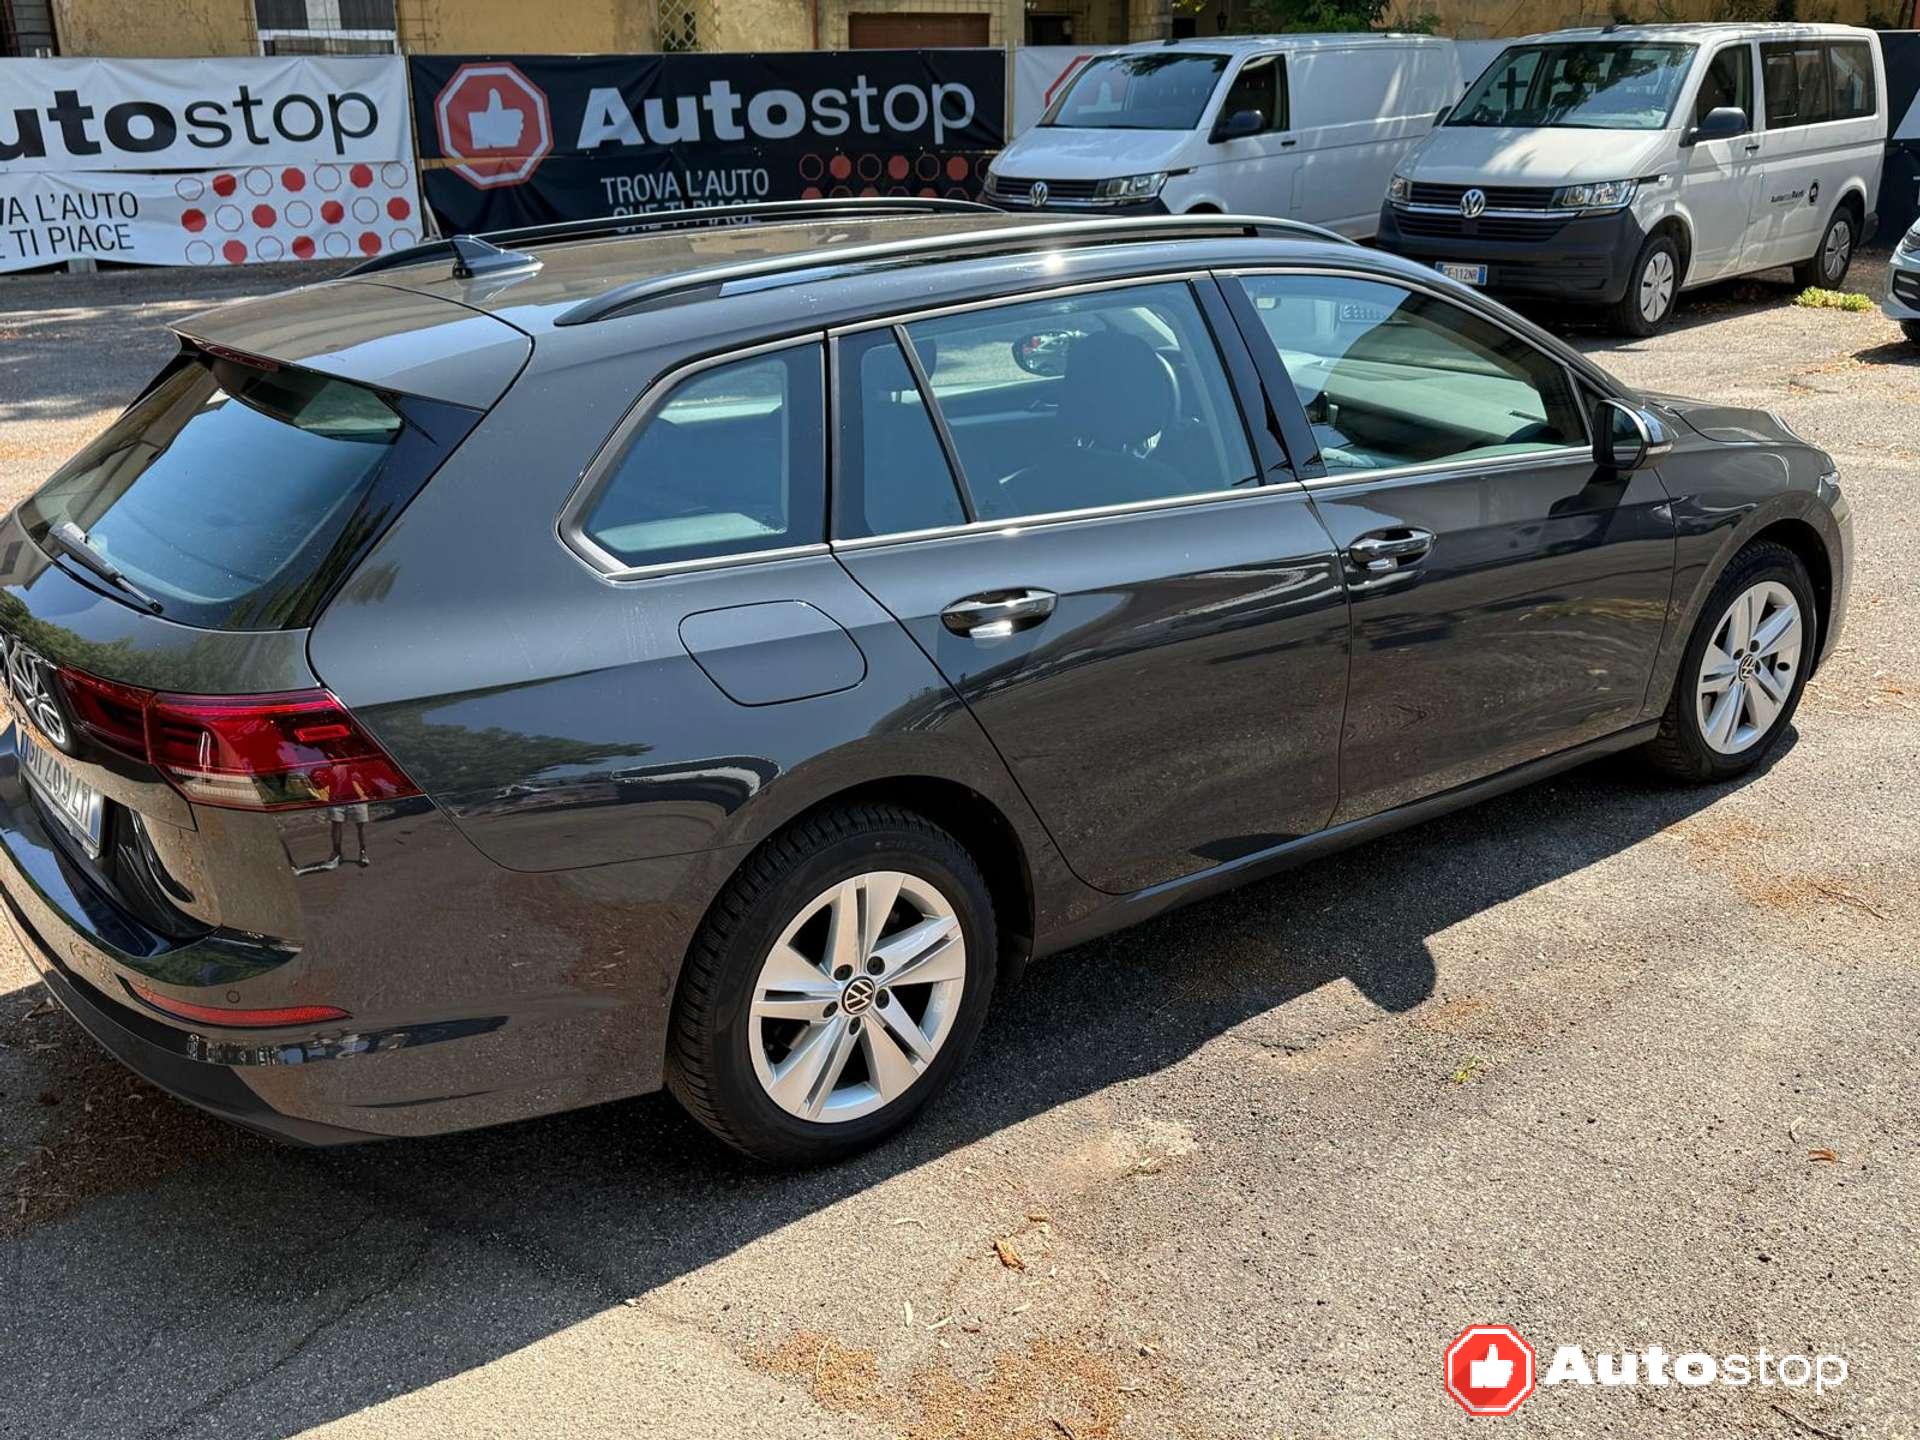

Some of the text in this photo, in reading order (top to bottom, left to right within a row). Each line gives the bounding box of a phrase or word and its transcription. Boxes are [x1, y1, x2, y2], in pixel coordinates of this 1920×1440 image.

[577, 75, 976, 148] Autostop
[600, 168, 769, 205] TROVA L'AUTO
[36, 191, 139, 222] L'AUTO
[9, 228, 39, 257] TI
[48, 223, 135, 255] PIACE
